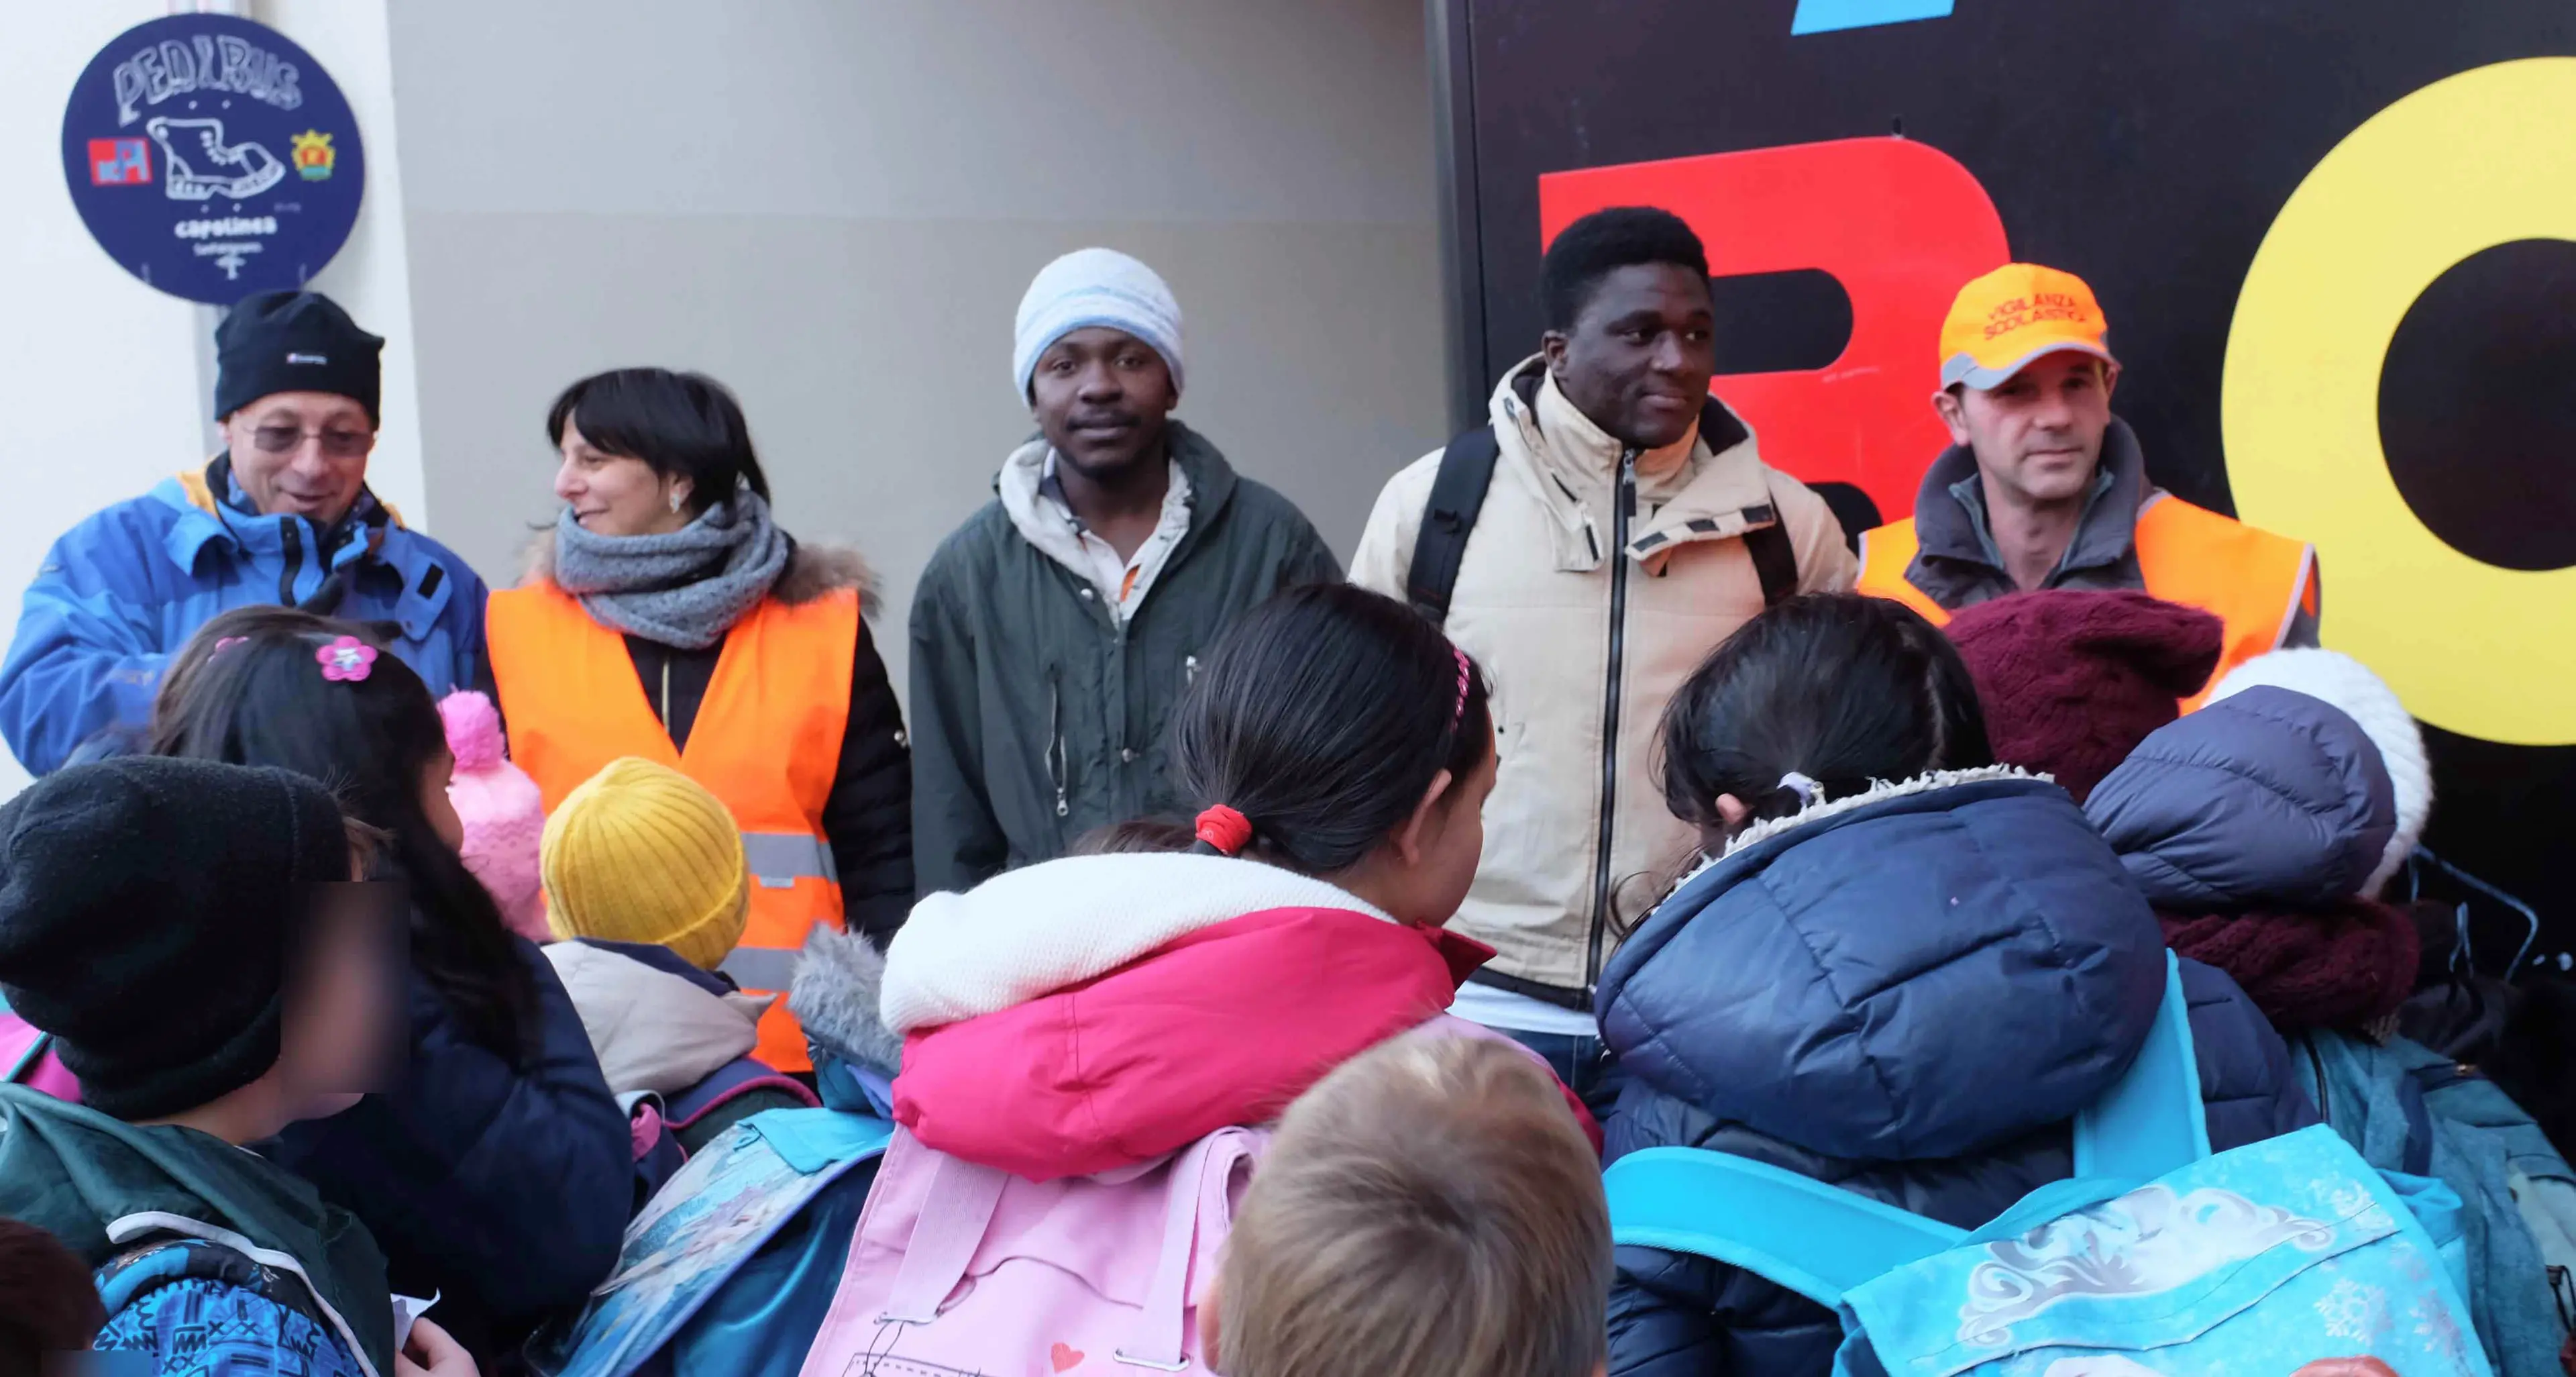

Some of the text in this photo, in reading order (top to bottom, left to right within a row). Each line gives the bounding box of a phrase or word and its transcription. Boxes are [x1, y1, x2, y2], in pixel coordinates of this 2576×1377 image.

[113, 34, 303, 128] PEDIBUS
[174, 215, 278, 240] capolinea
[1988, 293, 2076, 320] VIGILANZA
[1984, 307, 2087, 340] SCOLASTICA
